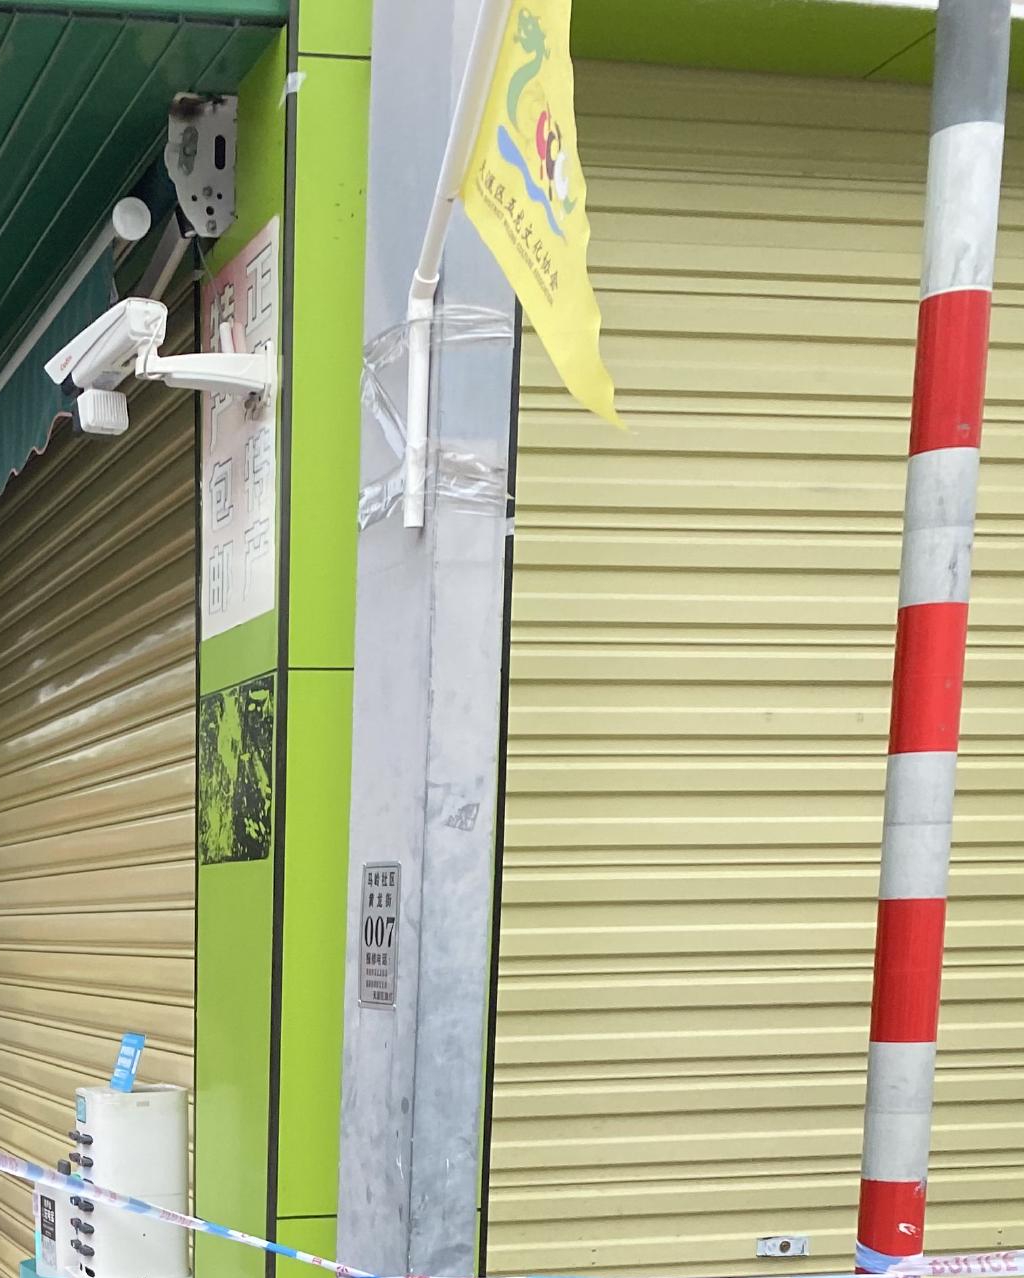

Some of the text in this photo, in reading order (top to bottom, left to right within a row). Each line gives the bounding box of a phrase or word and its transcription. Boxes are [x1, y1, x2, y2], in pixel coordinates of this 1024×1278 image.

[245, 241, 272, 601] 正特产
[364, 915, 395, 948] 007
